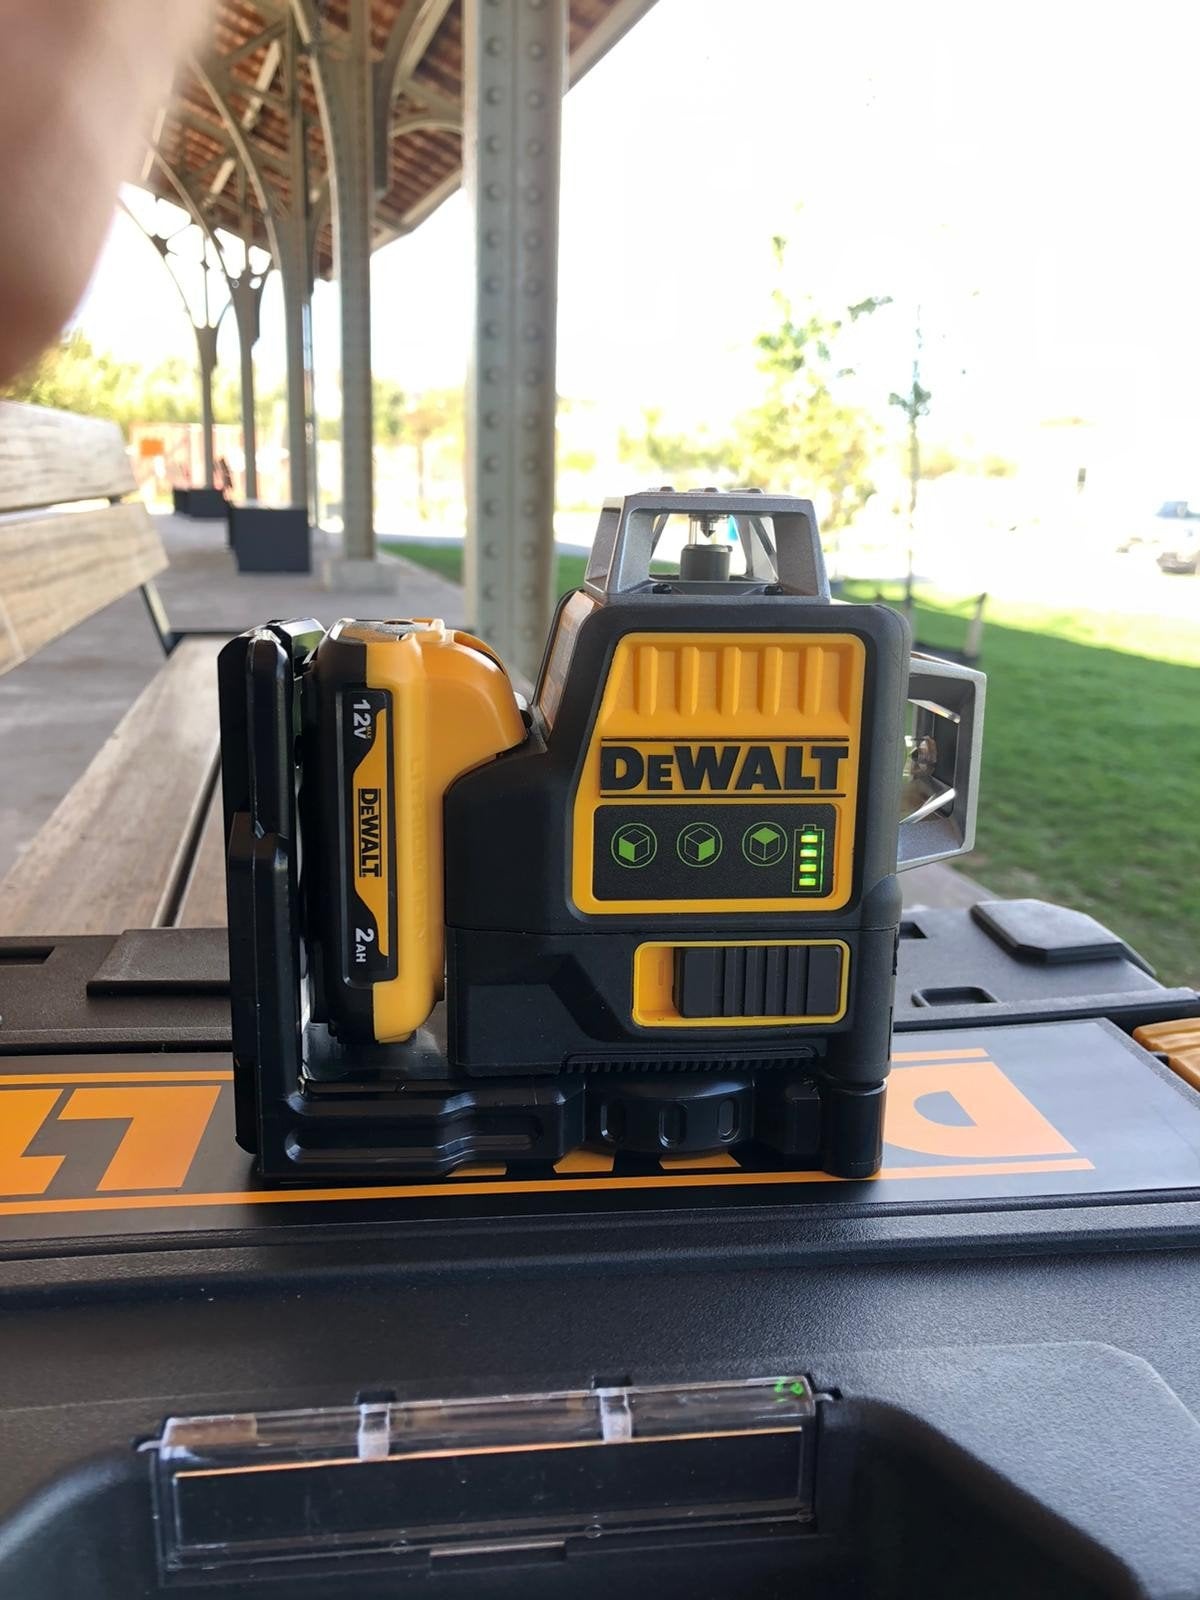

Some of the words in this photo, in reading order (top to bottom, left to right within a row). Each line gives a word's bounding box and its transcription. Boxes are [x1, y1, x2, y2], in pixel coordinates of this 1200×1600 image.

[353, 699, 371, 739] 12V
[600, 745, 849, 791] DEWALT
[360, 789, 379, 877] DEWALT
